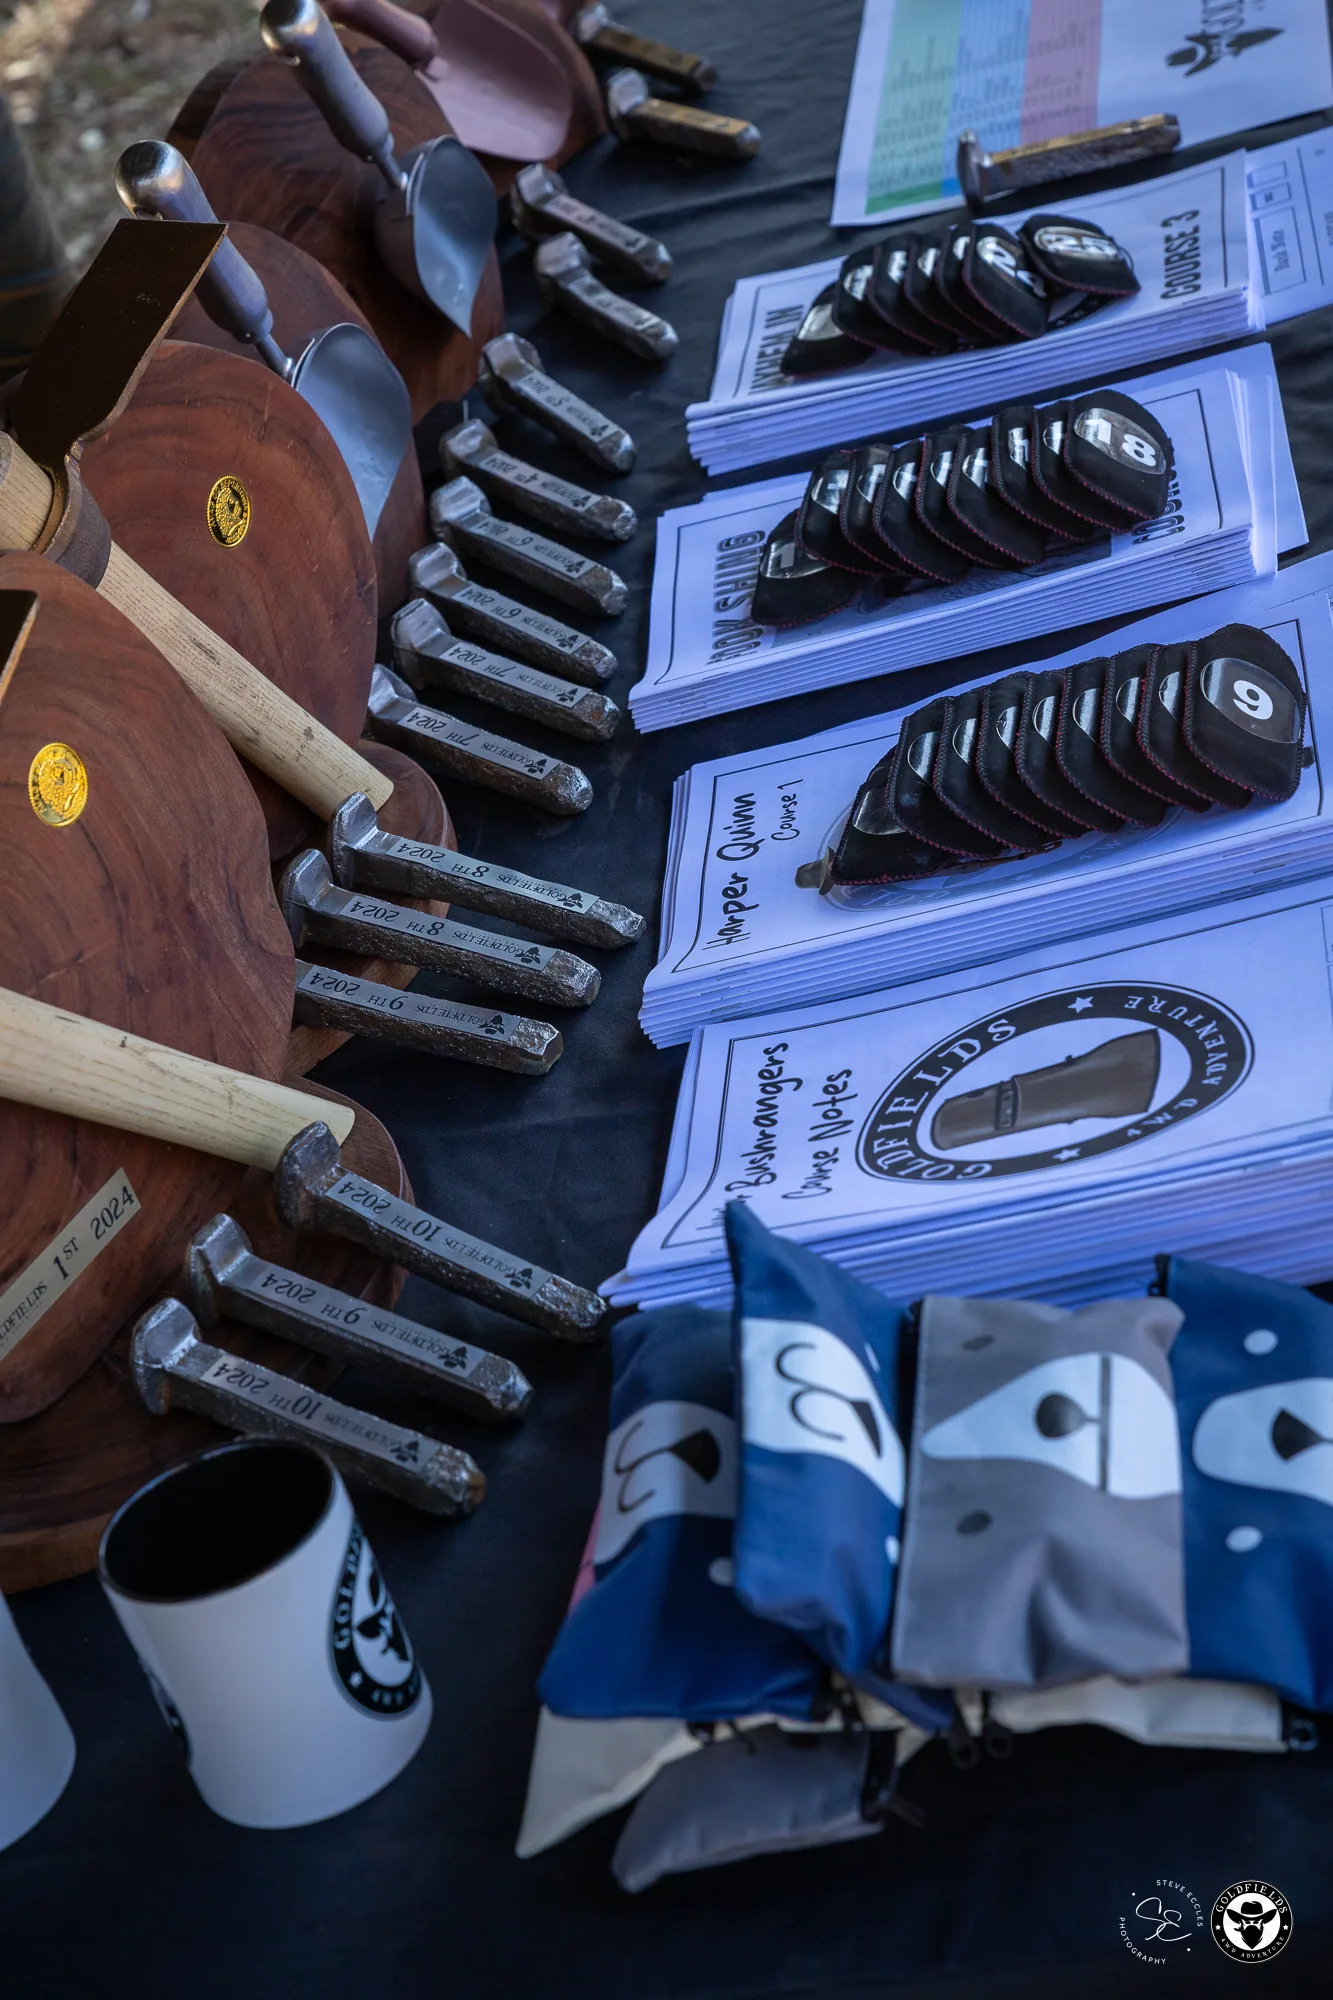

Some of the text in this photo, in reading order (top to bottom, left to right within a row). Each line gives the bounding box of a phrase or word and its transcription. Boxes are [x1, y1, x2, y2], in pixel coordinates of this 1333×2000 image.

[1160, 209, 1201, 299] COURSE 3
[1084, 418, 1157, 467] 18
[713, 529, 766, 613] SHING
[461, 588, 495, 606] 2024
[491, 606, 522, 619] 6TH
[448, 647, 487, 665] 2024
[484, 665, 517, 678] 7TH
[1233, 680, 1273, 720] 9
[406, 711, 535, 768] GOLDFIELDS 7TH 2024
[770, 778, 804, 841] Course 1
[397, 843, 446, 863] 2024
[451, 863, 490, 878] 8TH
[701, 792, 766, 951] Harper Quinn
[497, 874, 567, 901] GOLDFIELDS
[350, 901, 400, 922] 2024
[405, 921, 445, 936] 8TH
[452, 930, 524, 957] GOLDFIELDS
[309, 971, 360, 996] 2024
[367, 995, 408, 1011] 9TH
[415, 1004, 489, 1027] GOLDFIELDS
[1123, 995, 1229, 1086] ADVENTURE
[873, 1018, 1017, 1180] GOLDFIELDS
[724, 1042, 803, 1192] Bushrangers
[781, 1069, 859, 1200] Course Notes
[53, 1237, 79, 1281] 1ST
[90, 1185, 136, 1241] 2024
[338, 1181, 517, 1277] GOLDFIELDS 10TH 2024
[261, 1273, 450, 1356] GOLDFIELDS 9TH 2024
[212, 1363, 270, 1394] 2024
[269, 1394, 324, 1420] 10TH
